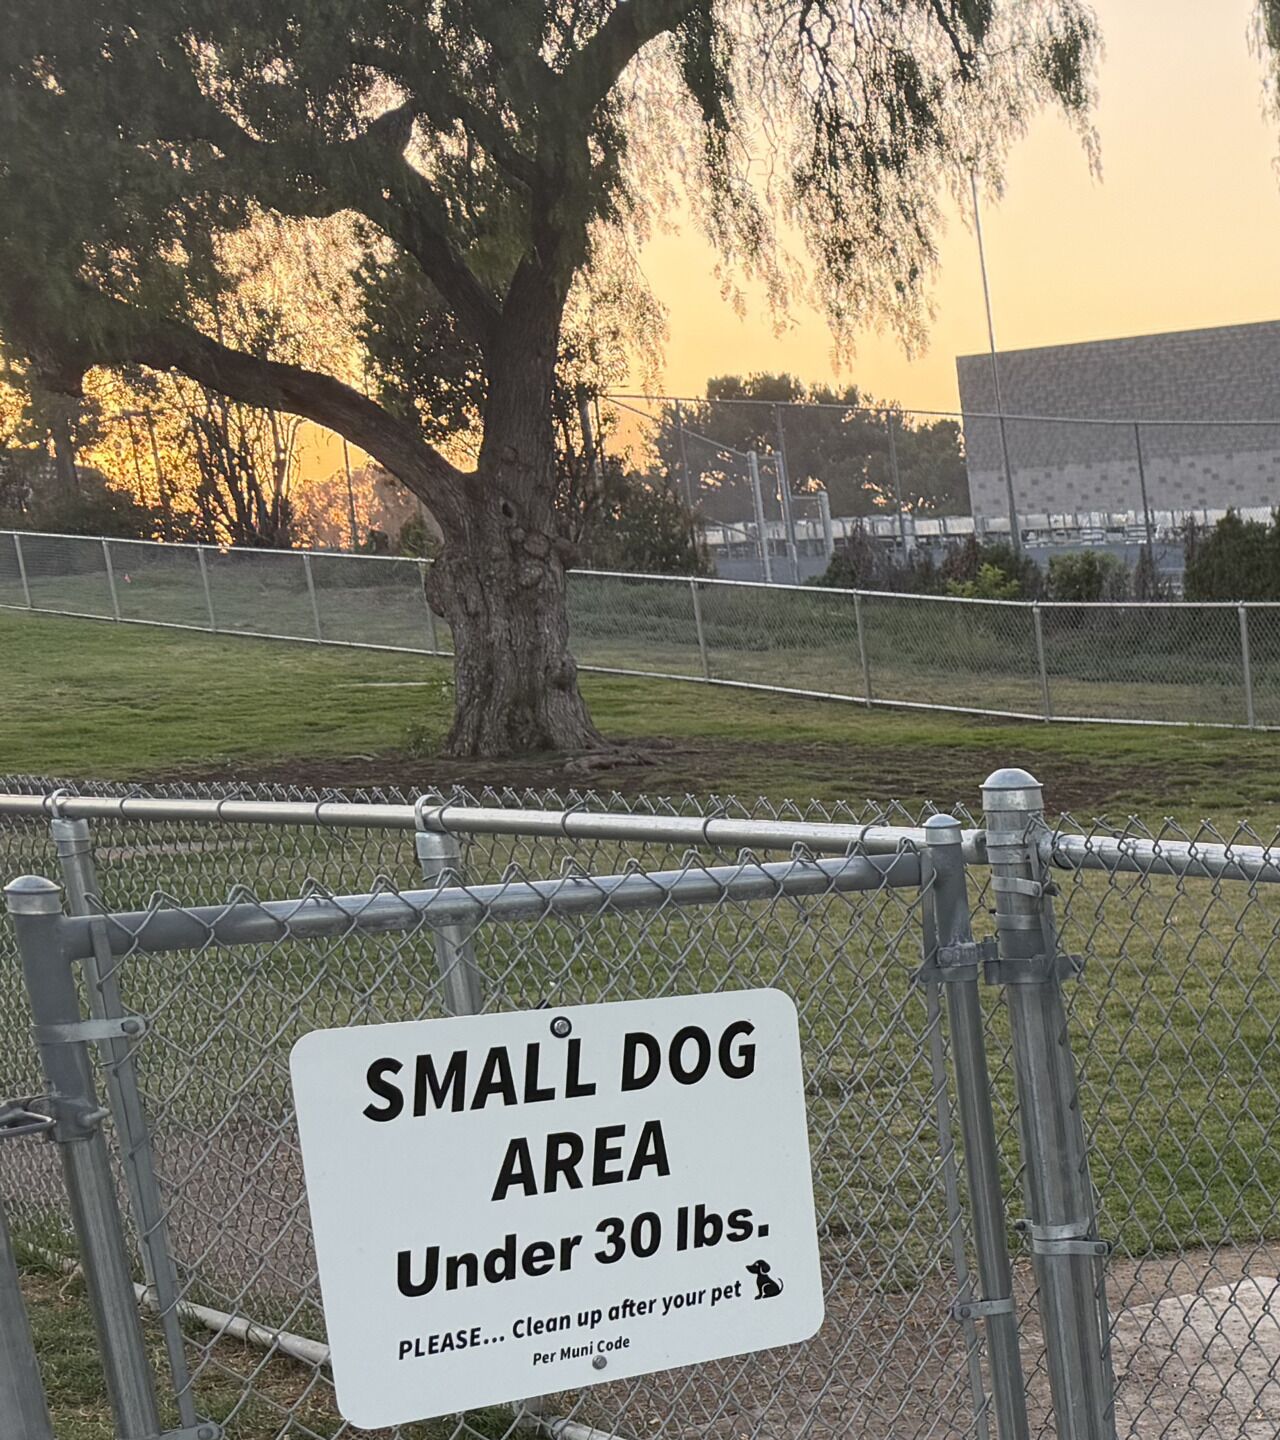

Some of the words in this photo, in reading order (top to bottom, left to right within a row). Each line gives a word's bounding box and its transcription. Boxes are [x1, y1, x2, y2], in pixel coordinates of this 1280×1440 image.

[362, 1037, 597, 1123] SMALL
[620, 1020, 756, 1093] DOG
[490, 1119, 671, 1202] AREA
[396, 1233, 583, 1298] Under
[594, 1211, 662, 1265] 30
[676, 1203, 770, 1252] lbs.
[398, 1326, 505, 1361] PLEASE...
[512, 1314, 571, 1339] Clean
[577, 1308, 603, 1330] up
[607, 1298, 657, 1321] after
[661, 1289, 707, 1317] your
[710, 1280, 742, 1307] pet
[532, 1351, 557, 1366] Per
[559, 1344, 594, 1361] Muni
[596, 1335, 630, 1353] Code
